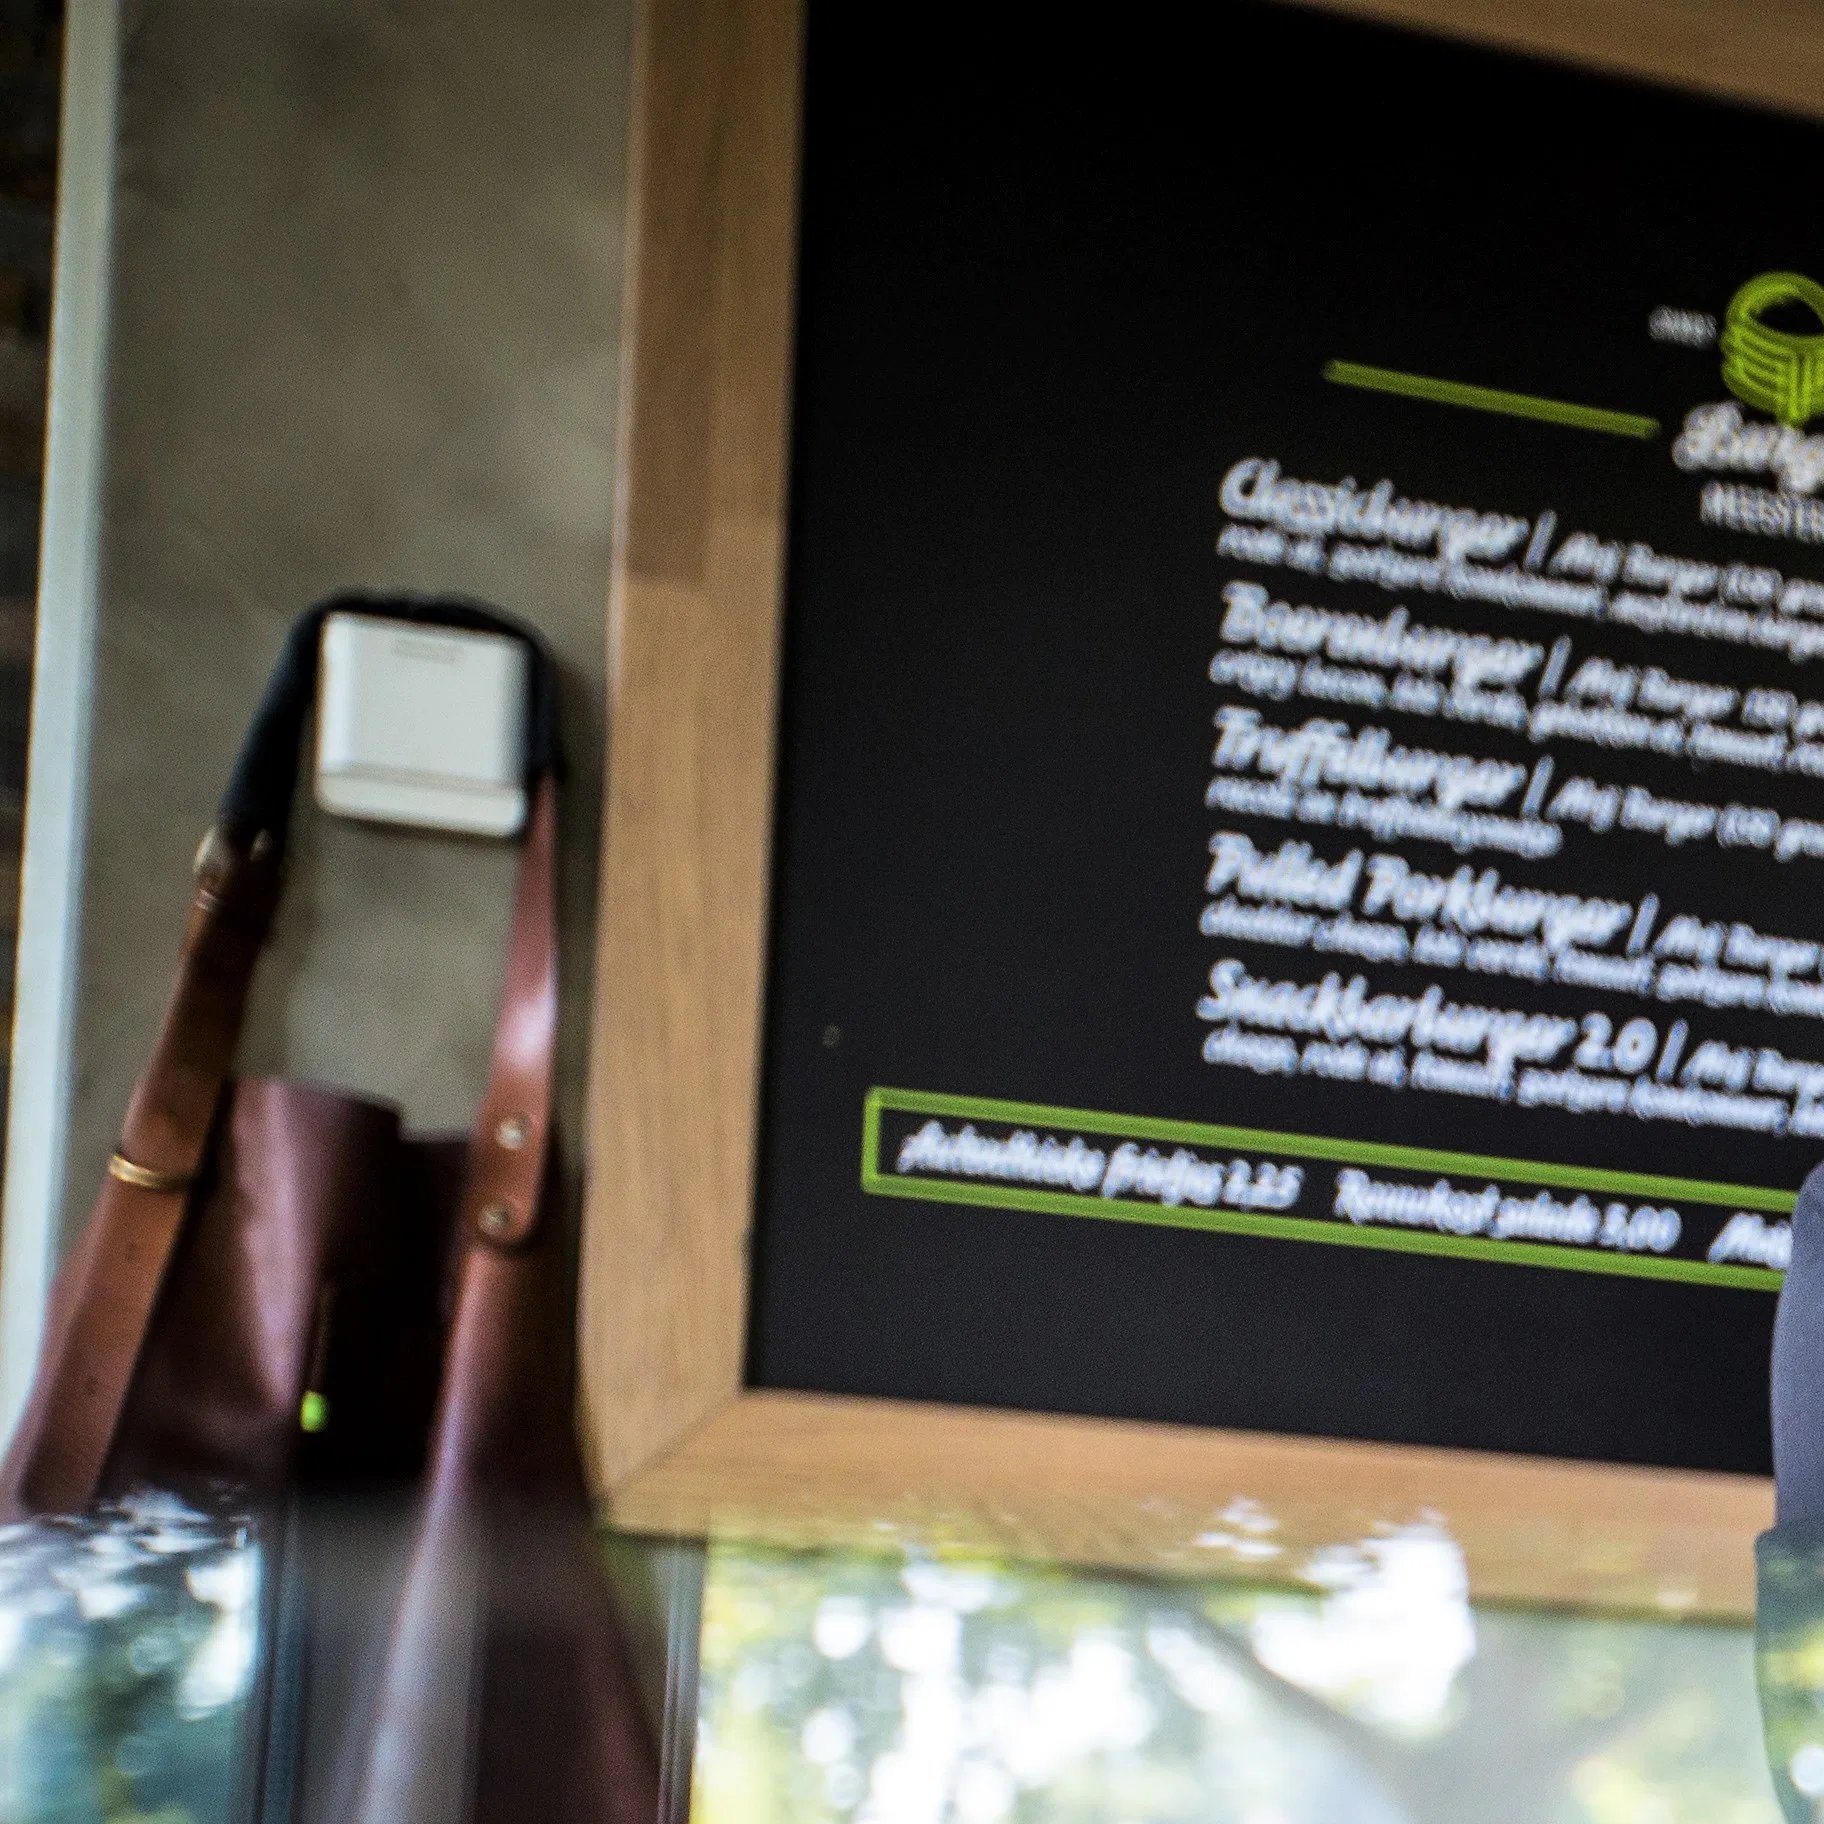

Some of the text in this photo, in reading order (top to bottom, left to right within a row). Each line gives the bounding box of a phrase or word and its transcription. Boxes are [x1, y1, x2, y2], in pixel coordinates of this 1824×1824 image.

[1220, 459, 1528, 564] Classicburger
[1222, 582, 1543, 685] Boerenburger
[1214, 705, 1530, 815] Truffelburger
[1207, 832, 1363, 910] Pulled
[1364, 854, 1633, 953] Porkburger
[1197, 959, 1577, 1072] Snackbarburger
[1574, 1013, 1657, 1073] 2.0
